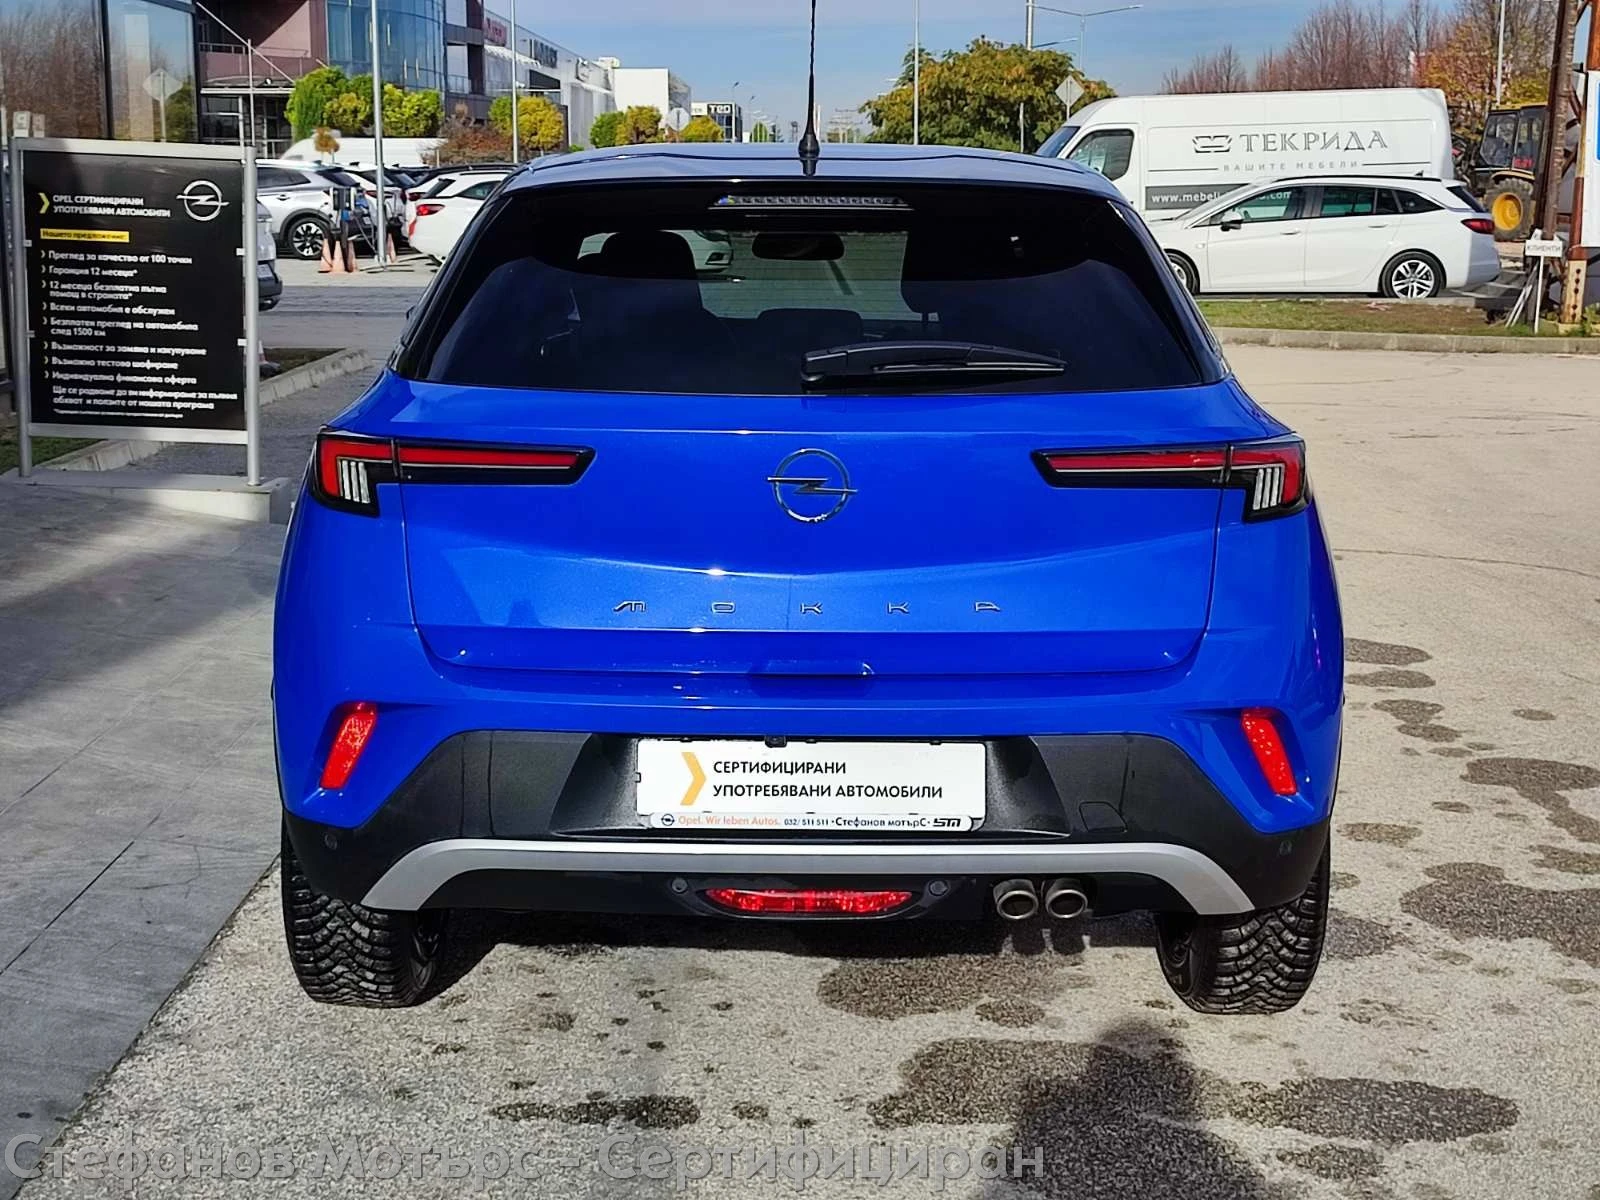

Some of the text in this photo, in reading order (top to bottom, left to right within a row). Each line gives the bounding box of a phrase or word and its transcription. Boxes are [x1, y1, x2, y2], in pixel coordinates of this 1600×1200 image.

[1240, 130, 1388, 152] ТЕКРИДА
[1223, 161, 1358, 172] ВАШИТЕ МЕБЕЛИ
[53, 195, 73, 203] OPEL
[49, 251, 85, 261] Преглед
[98, 254, 138, 262] качество
[151, 255, 166, 263] 100
[49, 265, 89, 276] Гаранция
[90, 267, 100, 275] 12
[49, 281, 59, 289] 12
[93, 282, 140, 292] безплатна
[50, 291, 80, 299] помощ
[50, 302, 75, 311] Всеки
[50, 317, 95, 327] Безплатен
[50, 328, 72, 336] след
[73, 328, 93, 336] 1500
[164, 374, 197, 385] оферта
[52, 385, 67, 394] Ще
[713, 760, 847, 776] СЕРТИФИЦИРАНИ
[712, 784, 943, 799] УПОТРЕБЯВАНИ АВТОМОБИЛИ
[706, 815, 721, 825] Wir
[723, 814, 750, 825] leben
